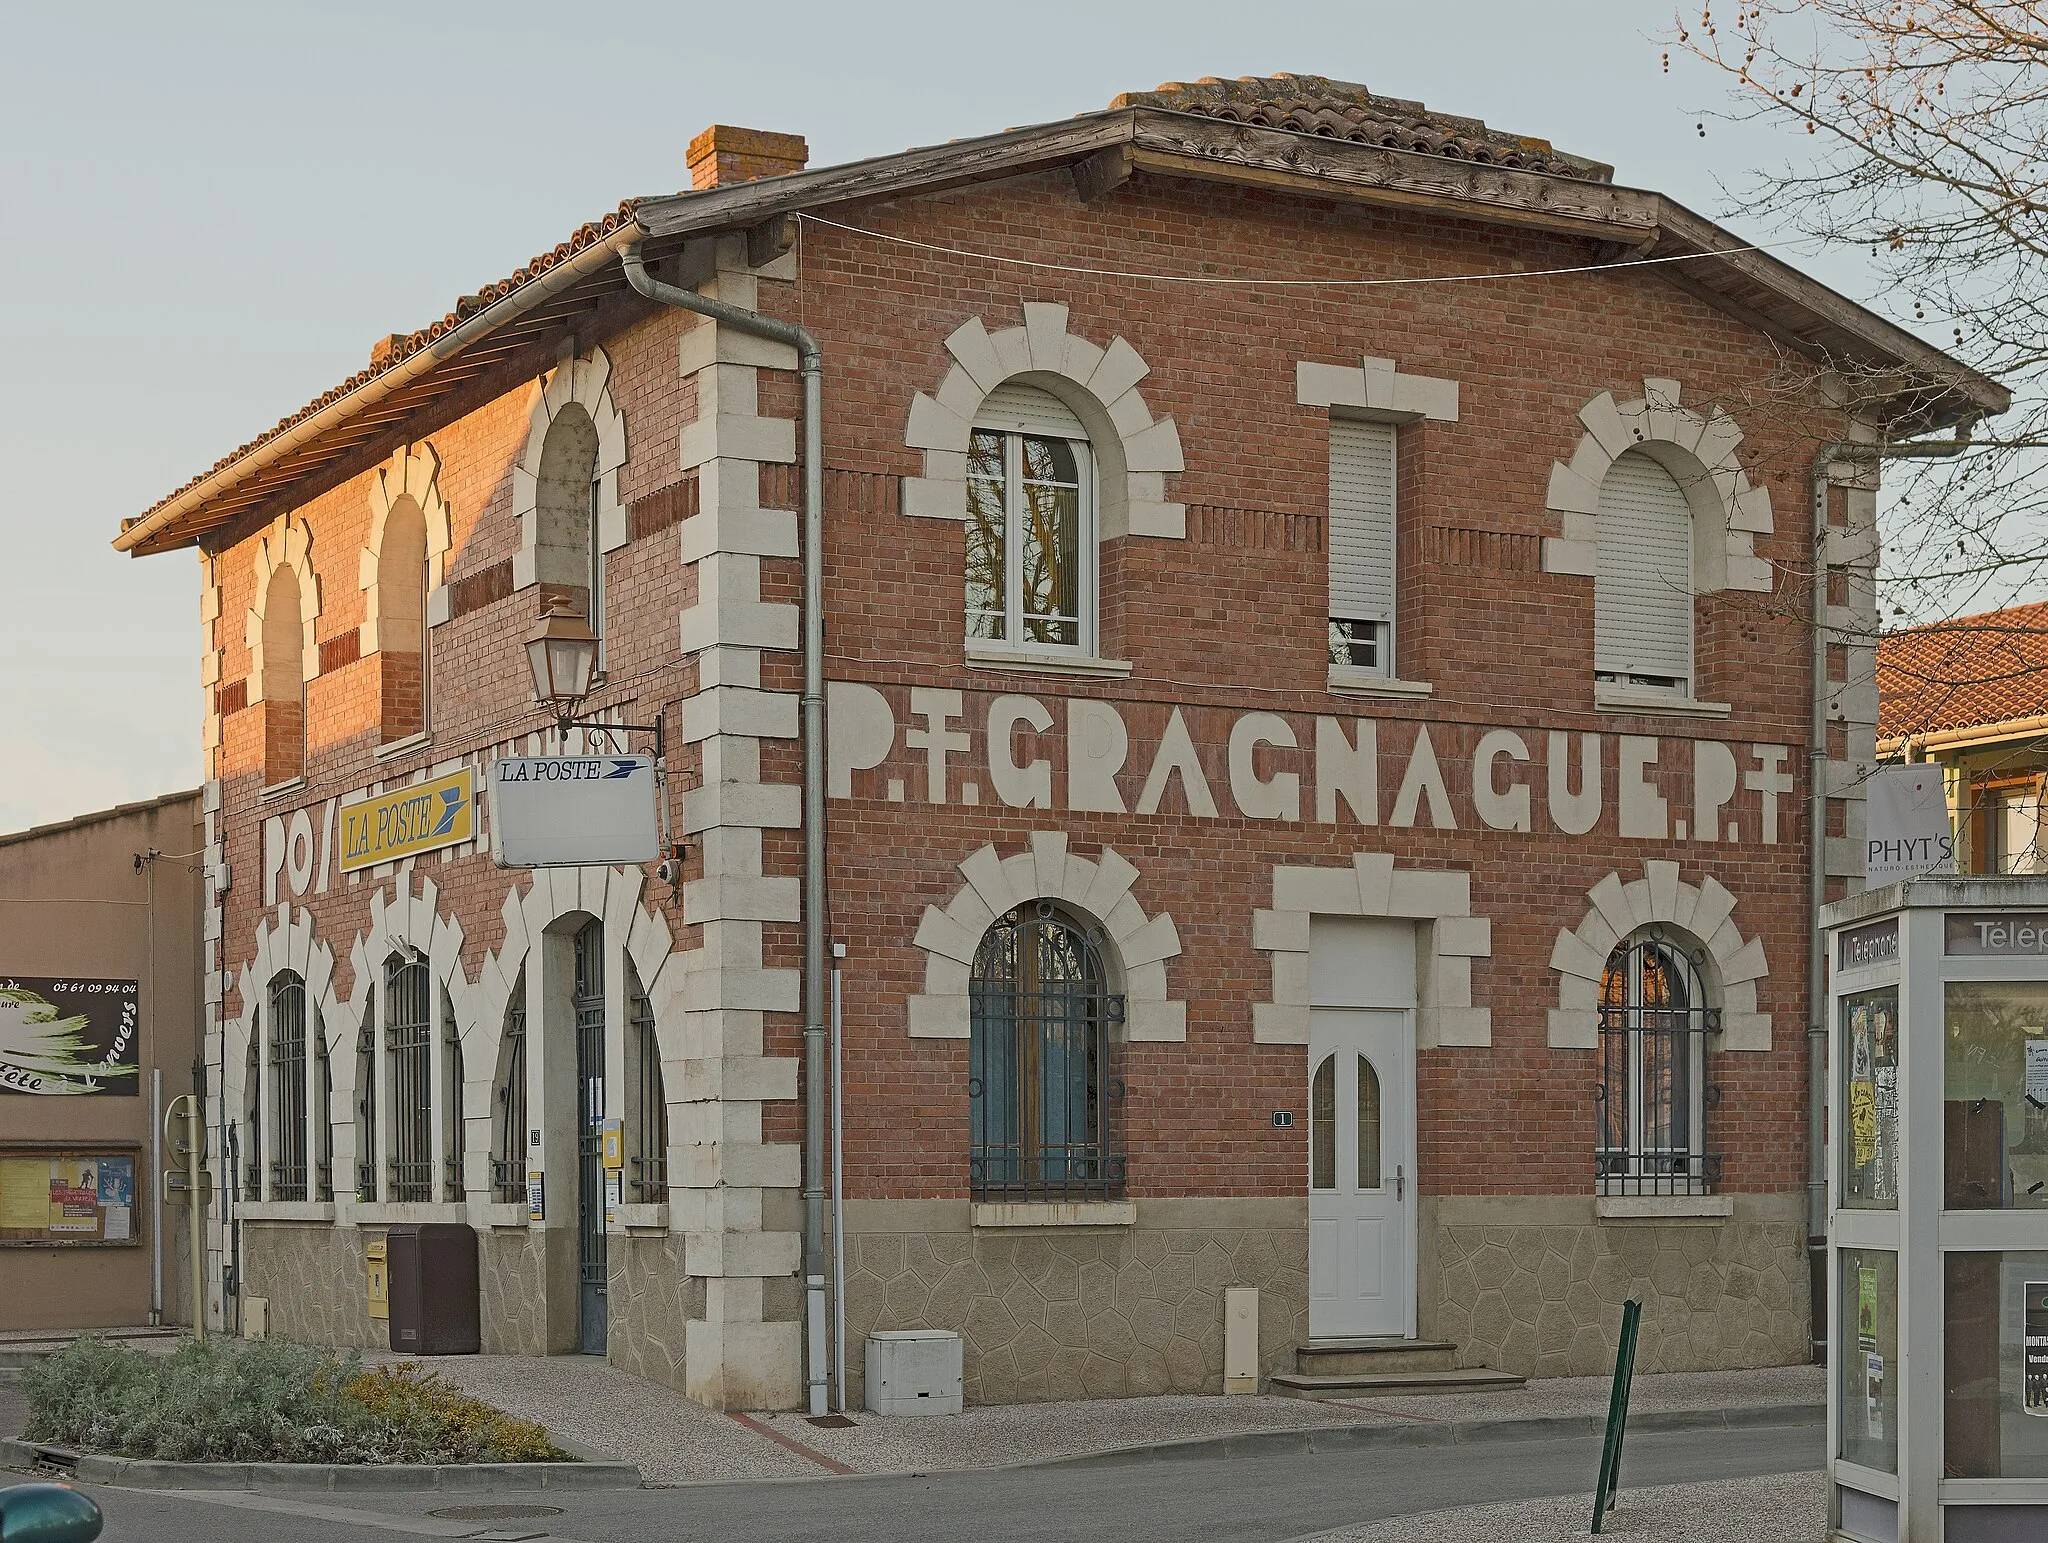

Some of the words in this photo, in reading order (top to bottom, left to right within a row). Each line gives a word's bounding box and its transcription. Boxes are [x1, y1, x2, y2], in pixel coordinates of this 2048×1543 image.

[500, 762, 529, 782] LA
[533, 761, 602, 781] POSTE
[346, 812, 370, 859] LA
[375, 794, 433, 851] POSTE
[1868, 833, 1953, 863] PHYT'S
[53, 983, 69, 993] 05
[70, 983, 85, 993] 61
[87, 983, 103, 994] 09
[104, 984, 120, 994] 94
[122, 984, 137, 994] 04
[1280, 1113, 1286, 1125] 1
[532, 1132, 539, 1143] 19
